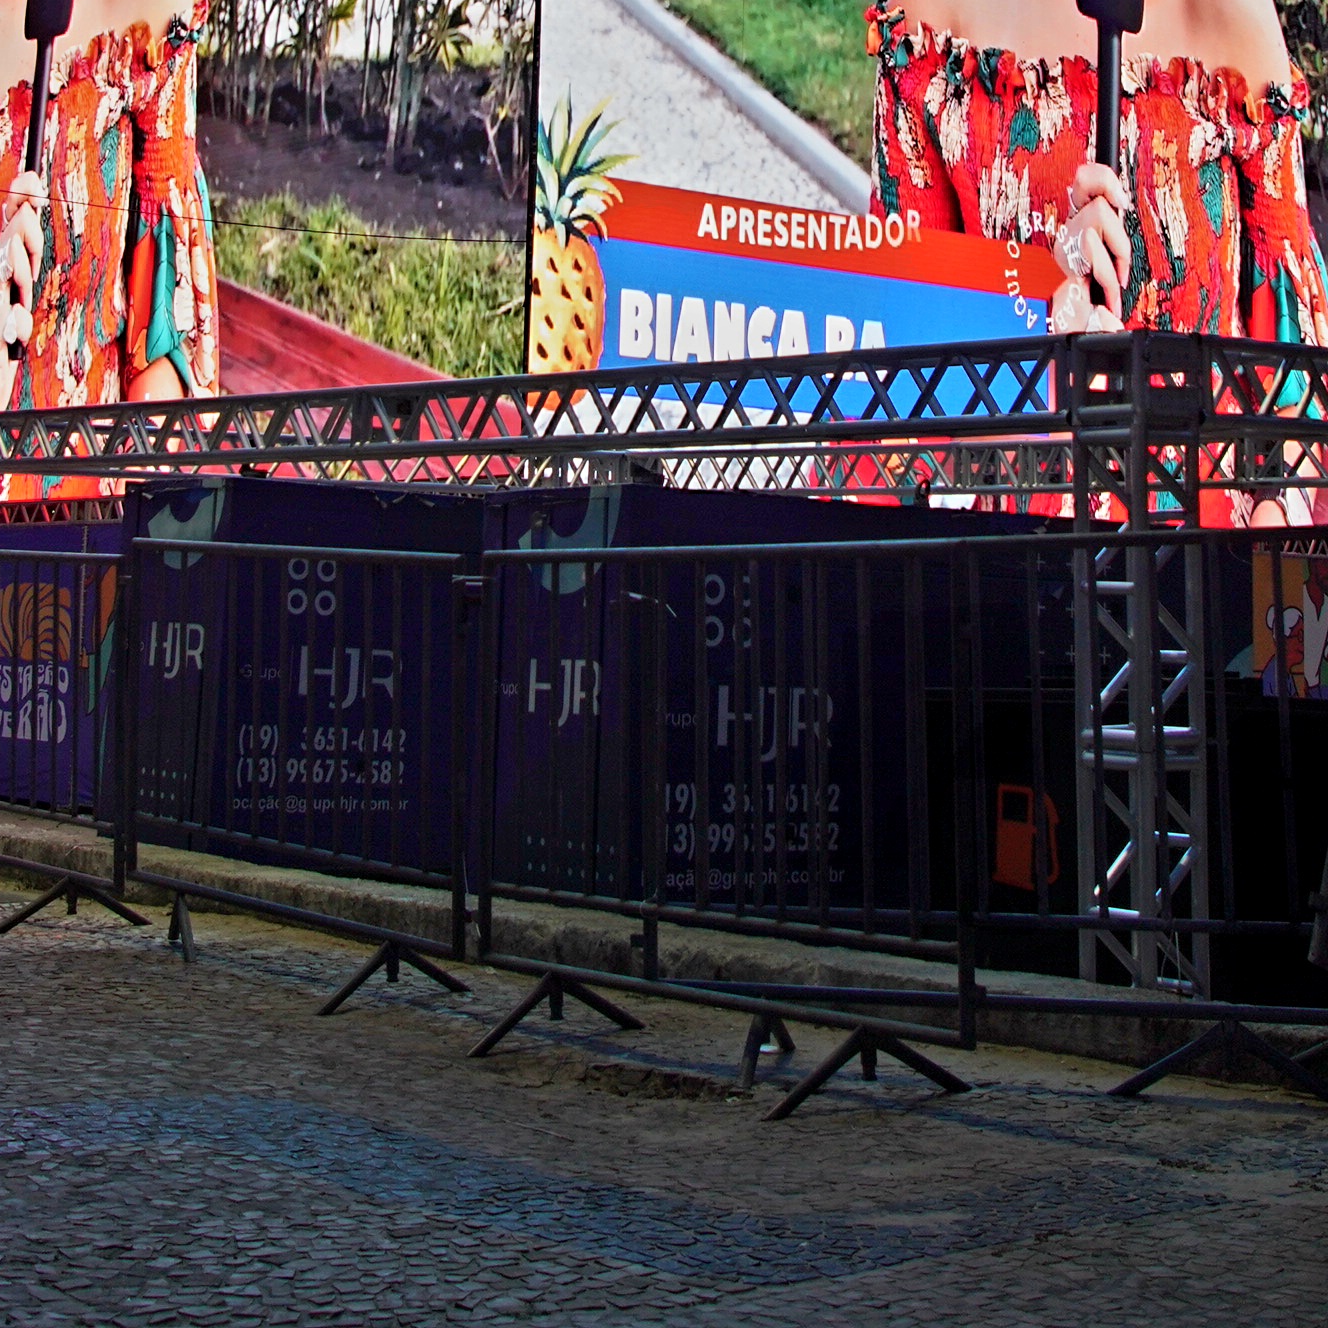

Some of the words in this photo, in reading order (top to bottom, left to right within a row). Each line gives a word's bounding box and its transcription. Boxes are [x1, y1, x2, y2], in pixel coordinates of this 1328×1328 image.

[697, 202, 922, 251] APRESENTADOR
[619, 288, 810, 363] BIANCA
[1005, 269, 1039, 330] AQUI
[149, 621, 205, 679] HJR
[240, 663, 281, 681] Gupo
[298, 645, 403, 709] HJR
[528, 658, 602, 728] HJR
[664, 782, 697, 821] 19)
